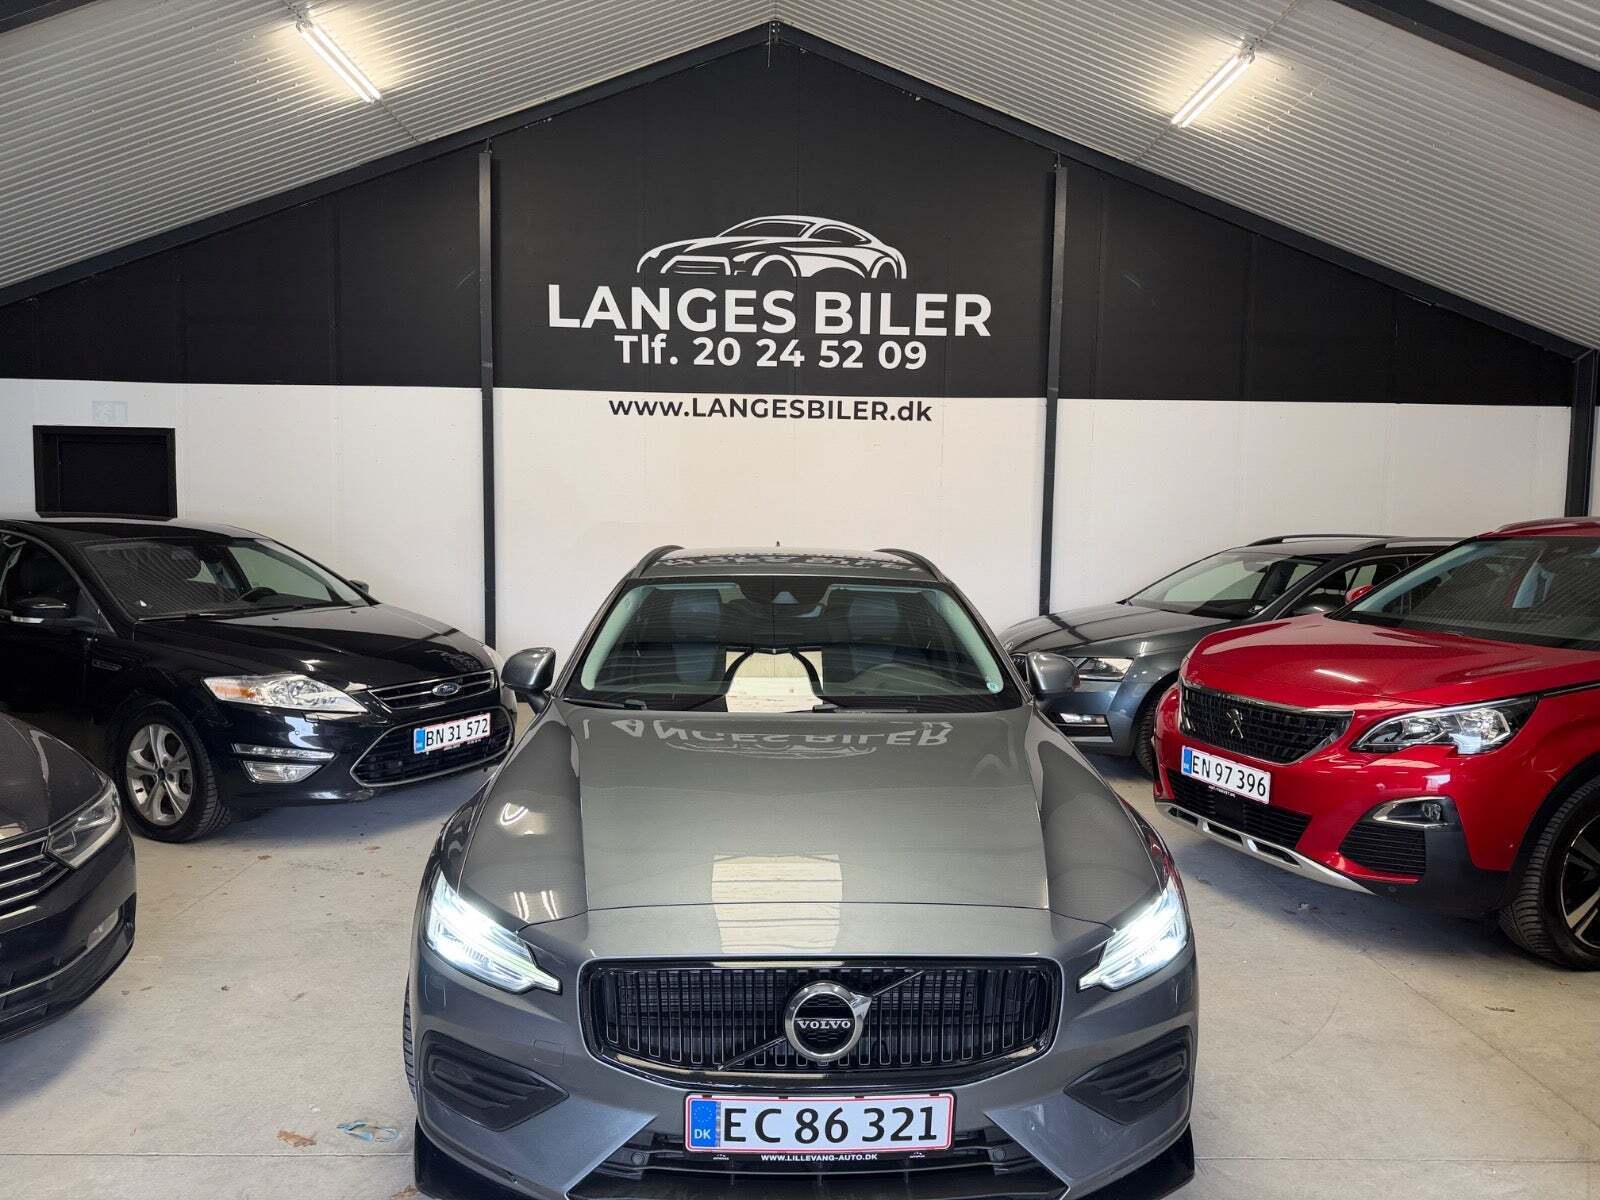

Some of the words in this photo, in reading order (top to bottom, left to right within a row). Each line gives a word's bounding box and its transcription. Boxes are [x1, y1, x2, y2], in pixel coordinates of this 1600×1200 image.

[548, 284, 797, 335] LANGES
[814, 291, 993, 337] BILER
[614, 334, 679, 365] Tlf.
[693, 337, 741, 366] 20
[756, 338, 805, 367] 24
[818, 340, 864, 369] 52
[878, 340, 928, 370] 09
[609, 397, 932, 422] www.LANGESBILER.dk
[426, 728, 444, 747] BN
[448, 725, 461, 742] 31
[466, 718, 488, 737] 572
[1193, 755, 1211, 778] EN
[1215, 763, 1232, 784] 97
[1237, 770, 1266, 797] 396
[797, 1020, 851, 1029] VOLVO
[694, 1128, 711, 1139] DK
[724, 1108, 782, 1143] EC
[794, 1107, 849, 1144] 86
[862, 1106, 937, 1142] 321
[760, 1153, 878, 1162] WWW.LILLEVANG-AUTO.DK
